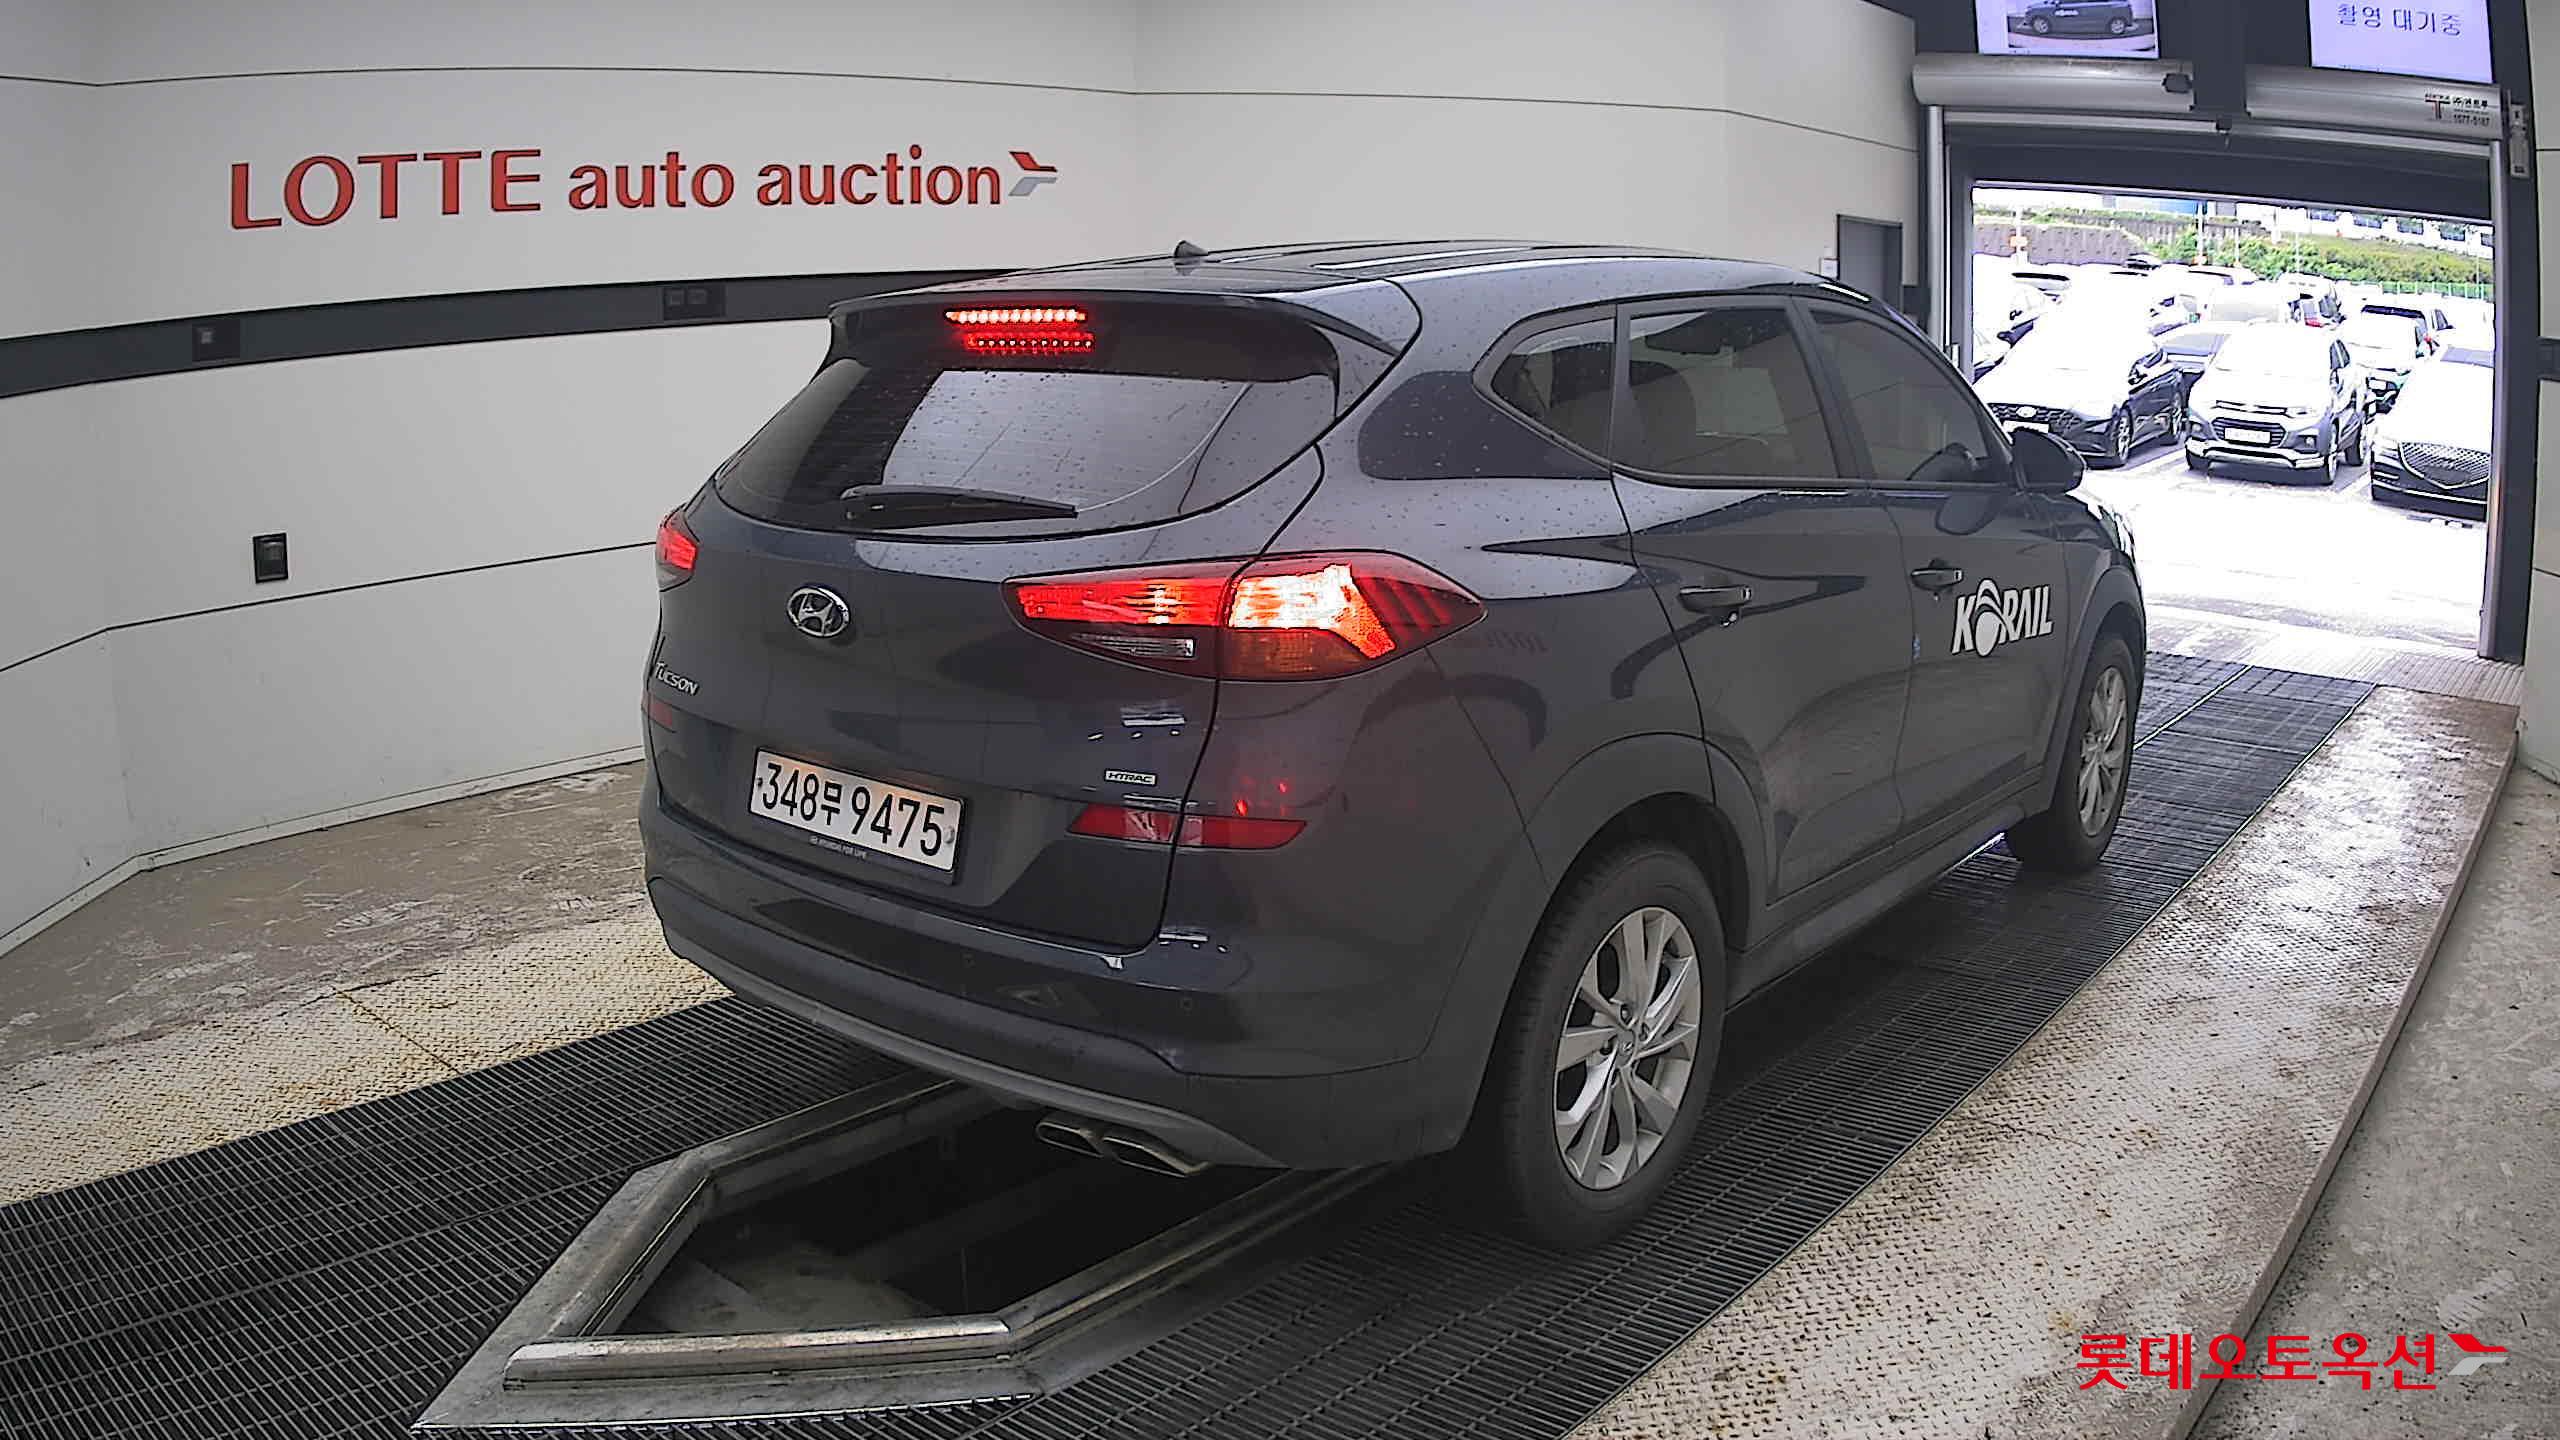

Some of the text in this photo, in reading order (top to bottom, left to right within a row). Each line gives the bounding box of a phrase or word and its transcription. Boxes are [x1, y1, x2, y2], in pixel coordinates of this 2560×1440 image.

[2338, 3, 2460, 36] 촬영 대기중
[229, 145, 1001, 229] LOTTE auto auction
[1951, 578, 2053, 657] KORAIL
[655, 662, 698, 694] TUCSON
[1106, 771, 1155, 785] HTRAC
[762, 763, 945, 856] 348무 9475
